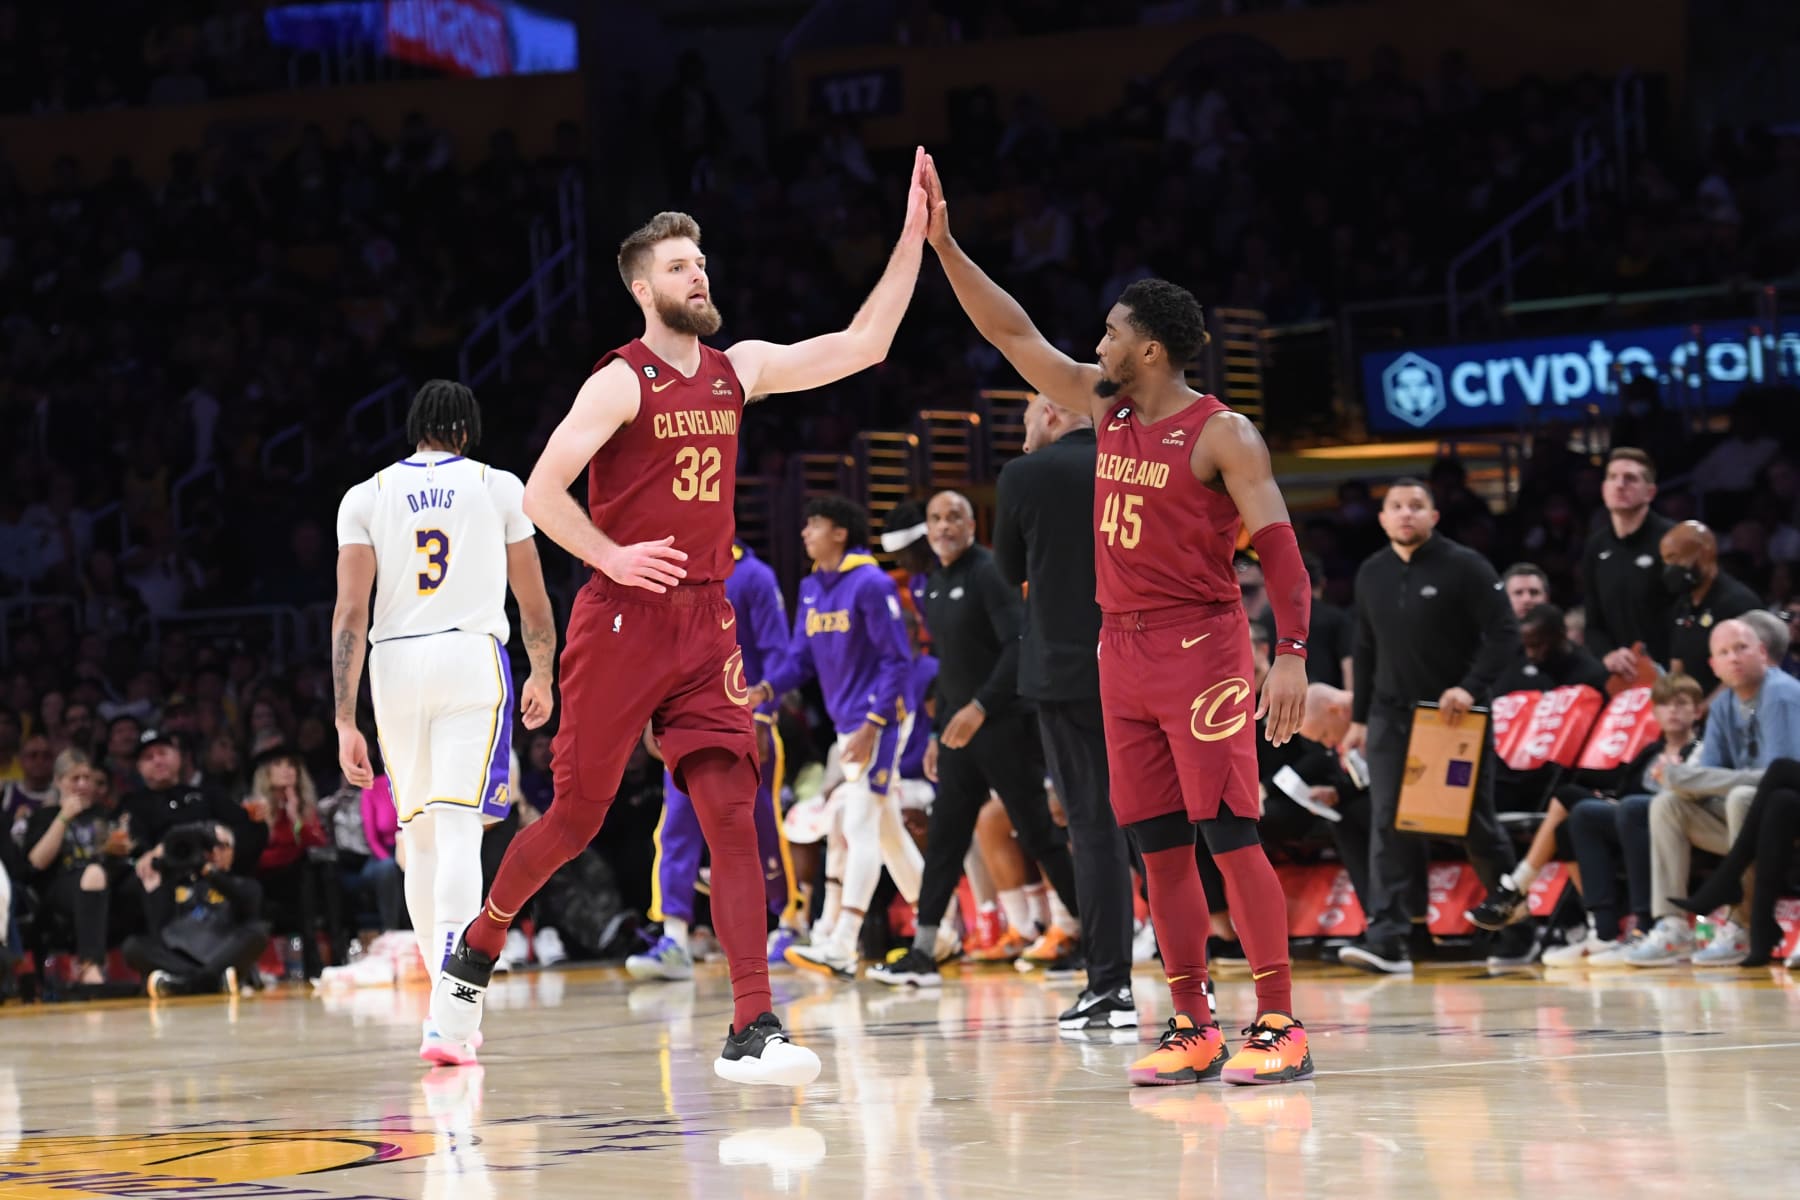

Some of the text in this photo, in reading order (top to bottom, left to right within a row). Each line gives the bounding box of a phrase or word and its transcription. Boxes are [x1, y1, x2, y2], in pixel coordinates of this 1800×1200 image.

[823, 74, 884, 114] 117
[643, 366, 657, 379] 6
[653, 410, 737, 439] CLEVELAND
[1116, 407, 1131, 419] 6
[1161, 438, 1184, 446] CLIFFS
[672, 446, 722, 502] 32
[1096, 452, 1170, 489] CLEVELAND
[407, 488, 455, 513] DAVIS
[1099, 491, 1144, 549] 45
[414, 527, 450, 596] 3
